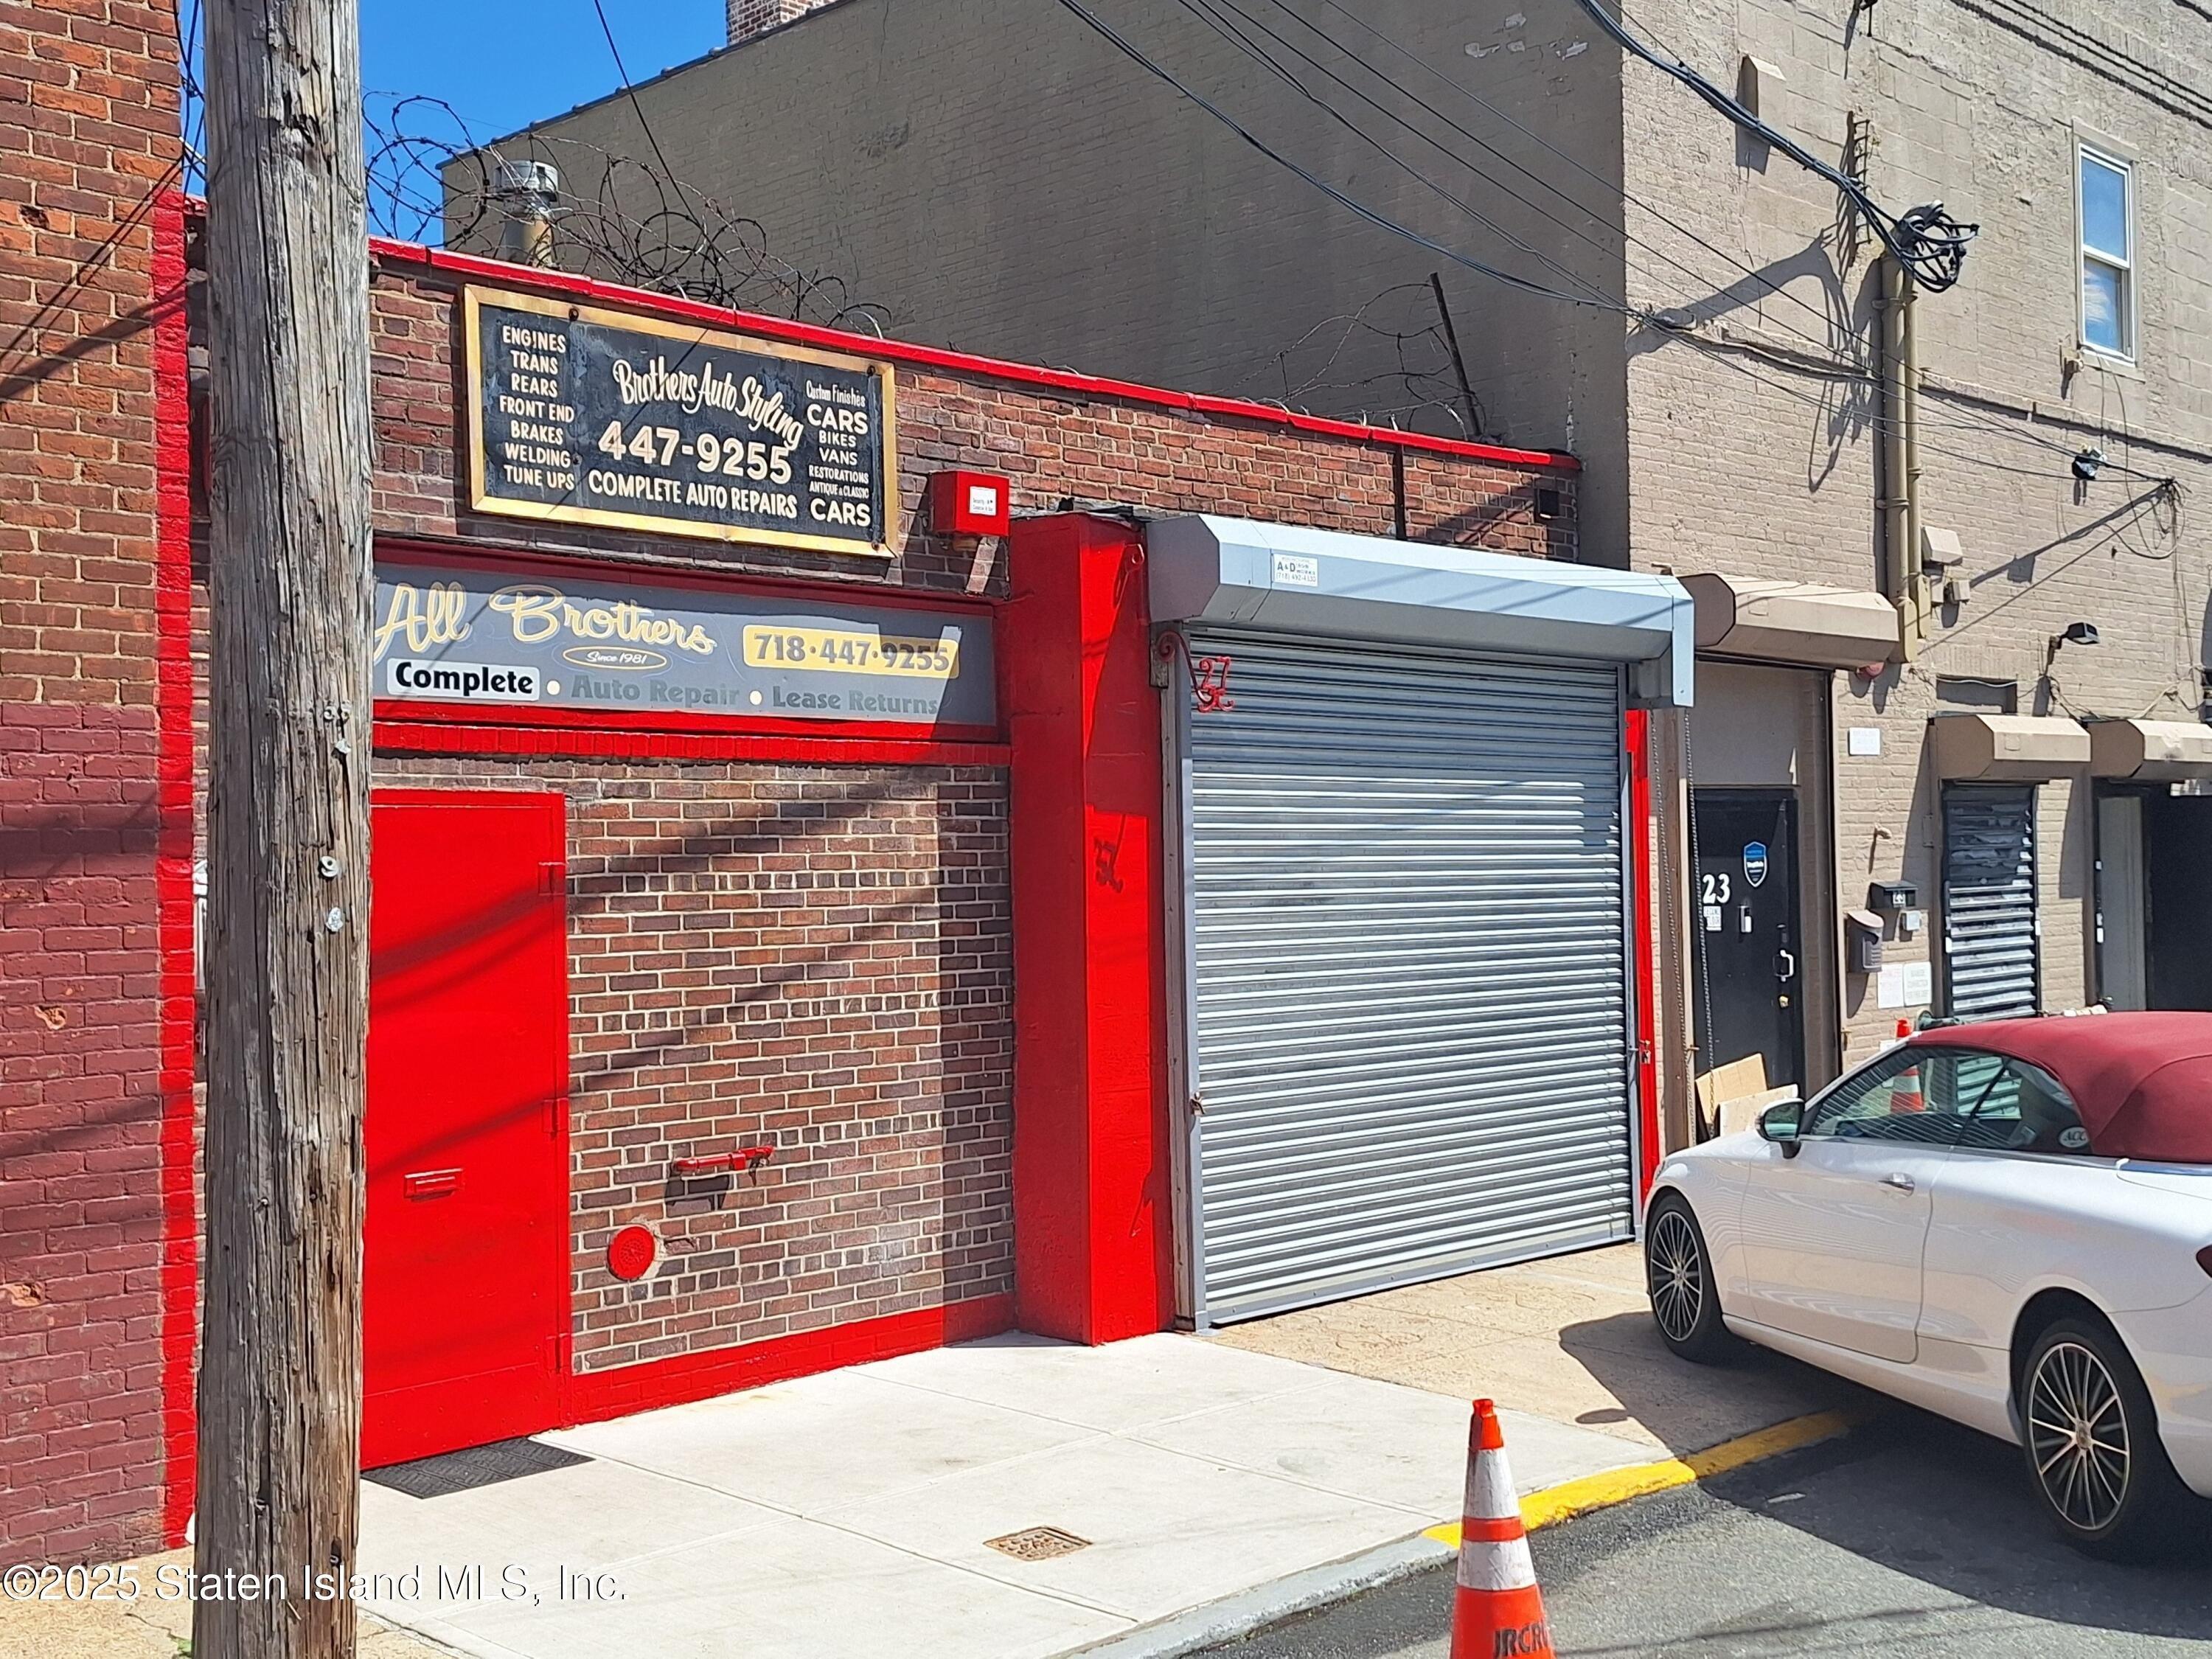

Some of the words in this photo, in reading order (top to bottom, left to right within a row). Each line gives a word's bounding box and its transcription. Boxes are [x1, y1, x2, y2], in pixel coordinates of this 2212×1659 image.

[502, 325, 566, 353] ENGINES
[510, 349, 558, 375] TRANS
[511, 372, 558, 397] REARS
[806, 380, 832, 401] Custom
[832, 384, 866, 408] Finishes
[499, 395, 546, 419] FRONT
[549, 403, 575, 422] END
[613, 355, 698, 405] Brothers
[682, 361, 737, 414] Auto
[735, 376, 804, 451] Styling
[510, 420, 563, 445] BRAKES
[807, 403, 869, 435] CARS
[598, 420, 792, 485] 447-9255
[819, 430, 857, 448] BIKES
[505, 442, 571, 468] WELDING
[819, 447, 858, 466] VANS
[504, 465, 543, 487] TUNE
[546, 471, 575, 491] UPS
[809, 465, 869, 484] RESTORATIONS
[588, 469, 682, 504] COMPLETE
[686, 482, 728, 509] AUTO
[731, 487, 798, 519] REPAIRS
[810, 481, 838, 497] ANTIQUE
[843, 485, 869, 499] CLASSIC
[810, 498, 871, 527] CARS
[374, 582, 473, 667] All
[490, 584, 717, 655] Brothers
[585, 650, 618, 663] Since
[619, 652, 647, 664] 1981
[395, 662, 534, 696] Complete
[571, 675, 641, 700] Auto
[650, 679, 740, 708] Repair
[773, 686, 841, 710] Lease
[849, 689, 939, 714] Returns
[1703, 873, 1731, 904] 23
